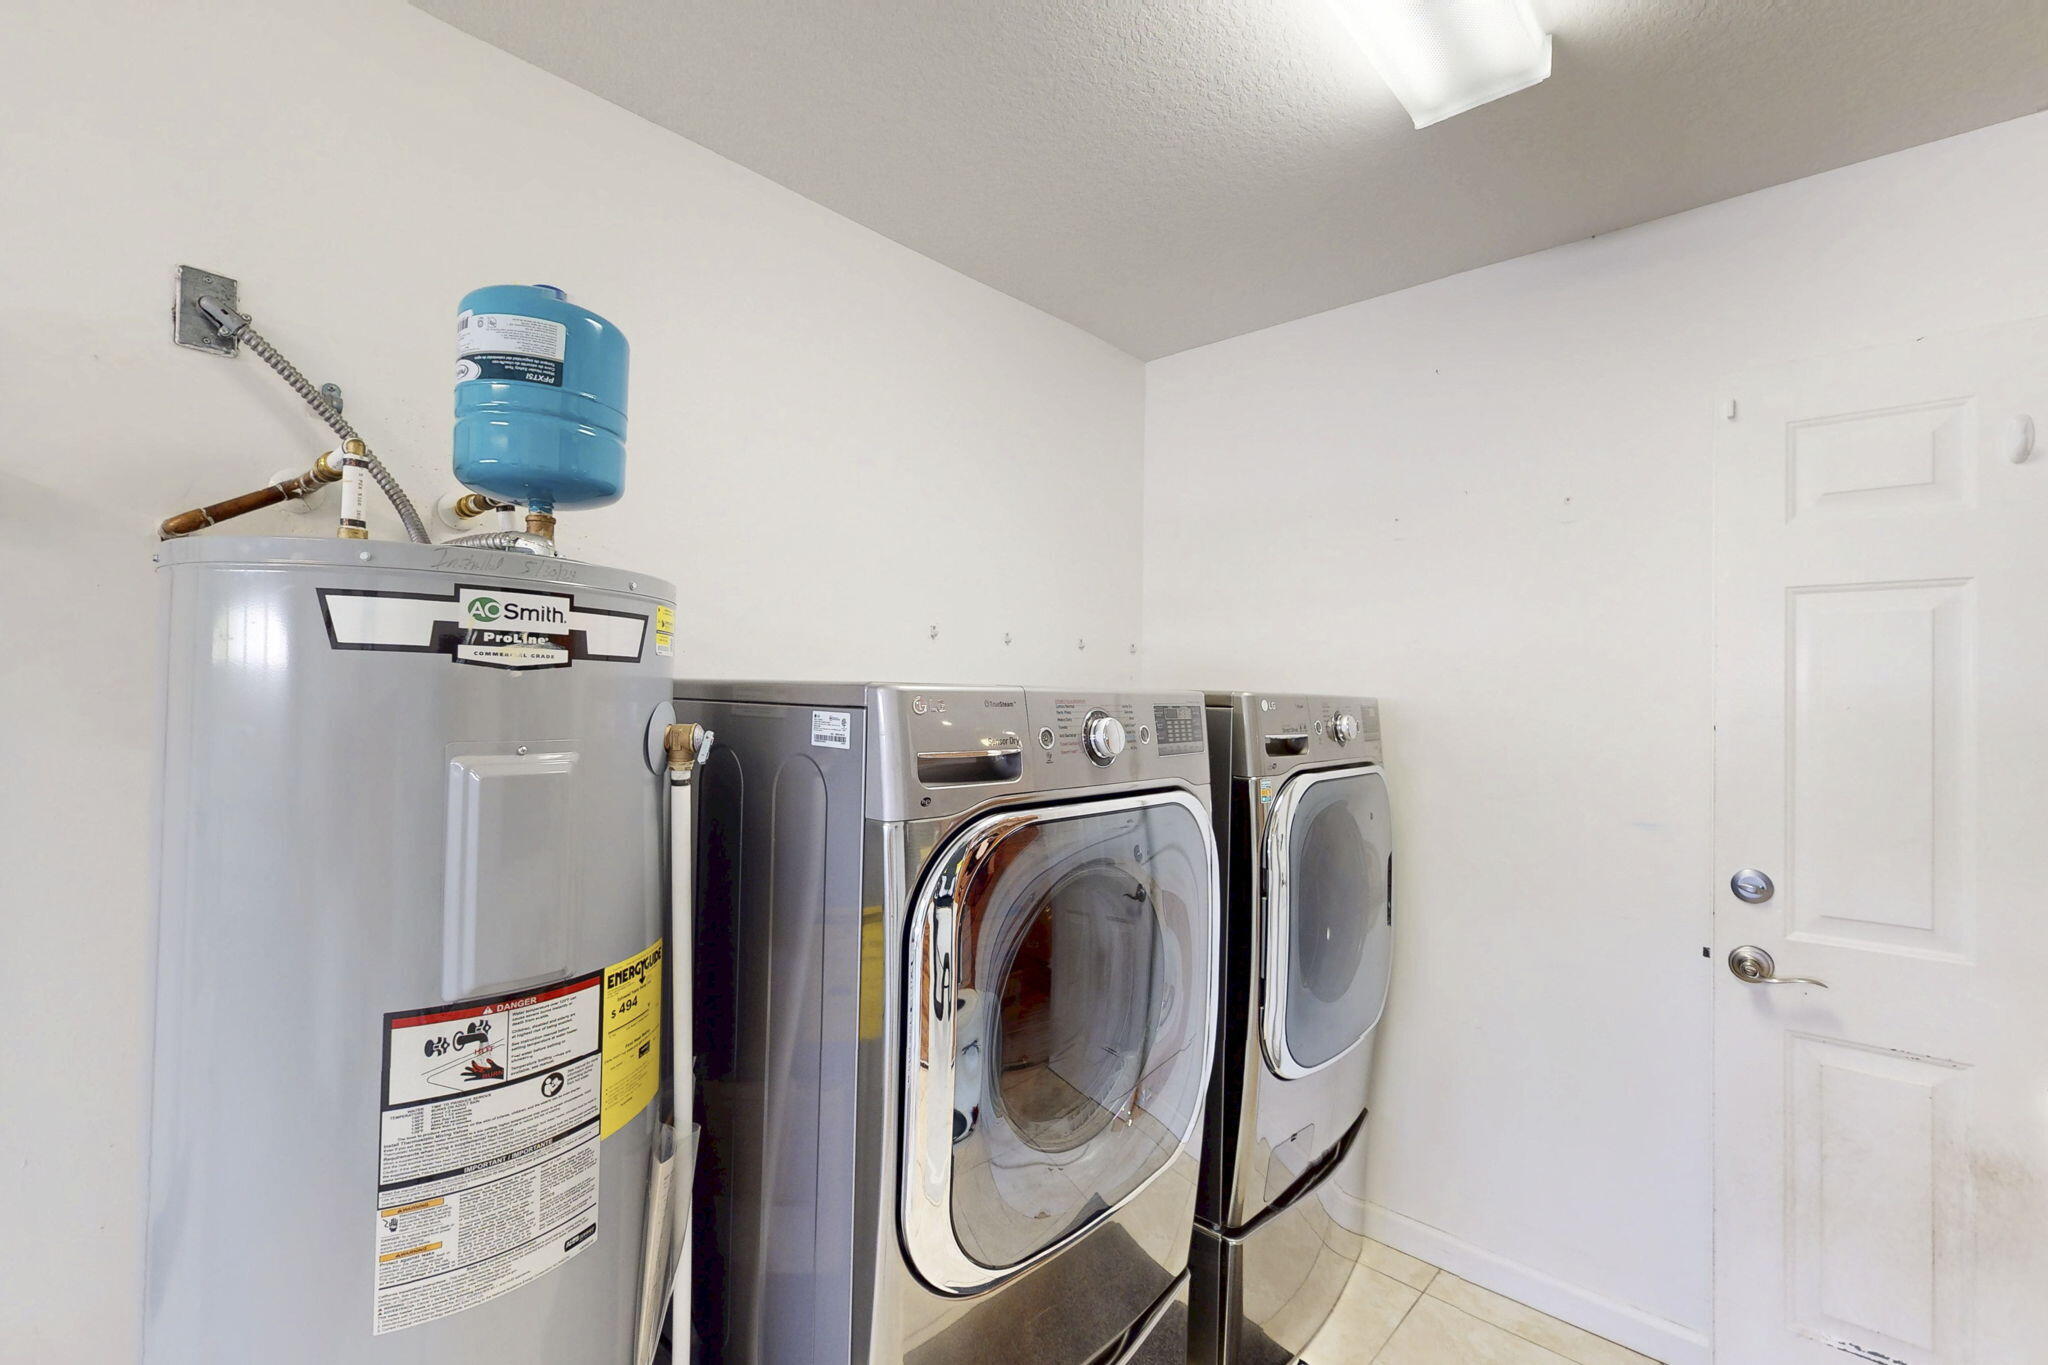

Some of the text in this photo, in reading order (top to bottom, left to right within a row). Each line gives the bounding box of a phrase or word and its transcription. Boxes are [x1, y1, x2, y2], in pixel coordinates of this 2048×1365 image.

[484, 632, 546, 645] ProLine
[1269, 702, 1276, 710] LG
[1010, 736, 1020, 746] Dry
[496, 997, 537, 1013] DANGER
[619, 996, 638, 1014] 494
[464, 1156, 507, 1174] IMPORTANT
[512, 1138, 554, 1158] IMPORTANTE
